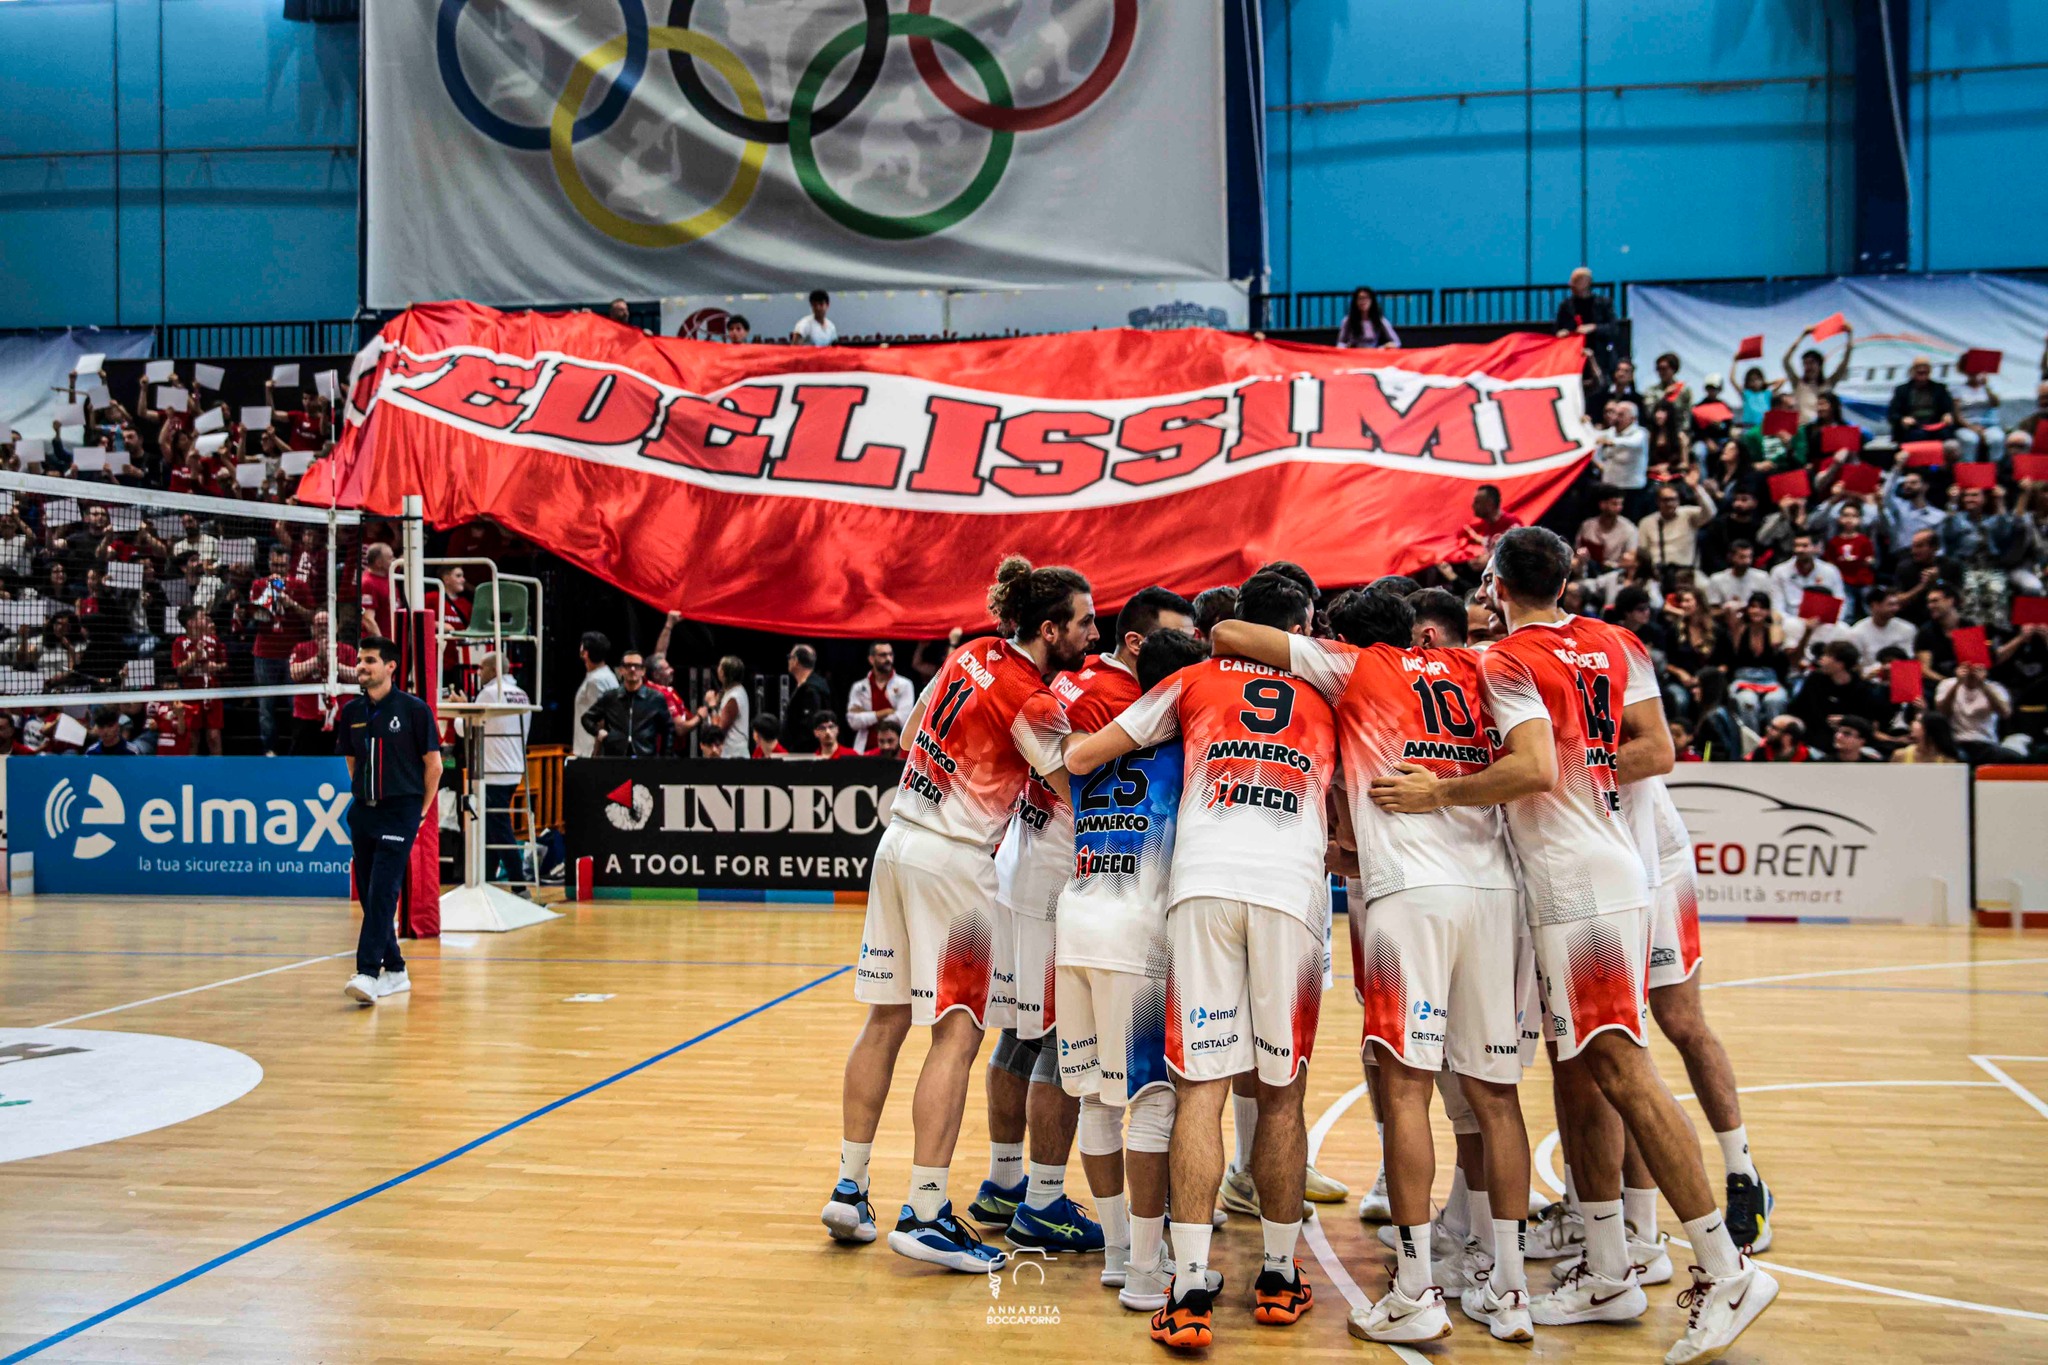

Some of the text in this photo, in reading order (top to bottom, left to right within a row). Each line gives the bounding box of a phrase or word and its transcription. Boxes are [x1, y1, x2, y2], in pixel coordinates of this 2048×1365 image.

[931, 677, 974, 740] 11
[1239, 678, 1296, 735] 9
[1411, 674, 1476, 738] 10
[1576, 670, 1616, 744] 14
[1207, 740, 1312, 774] AMMERCO
[1080, 747, 1158, 812] 25
[139, 783, 353, 852] elmax
[1075, 813, 1149, 836] AMMERCO
[139, 856, 351, 874] la tua sicurezza in una mano
[606, 853, 869, 879] A TOOL FOR EVERY
[1694, 844, 1867, 877] EO RENT
[1696, 886, 1766, 903] obilità
[870, 947, 894, 958] elmax
[911, 988, 933, 998] DECO
[991, 996, 1017, 1005] ALSUD
[1018, 1001, 1040, 1012] DECO
[1190, 1034, 1239, 1051] CRISTALSUD
[1254, 1036, 1291, 1057] INDECO
[1101, 1069, 1124, 1080] DECO
[1402, 1241, 1417, 1259] NIKE
[1518, 1232, 1526, 1252] NIKE
